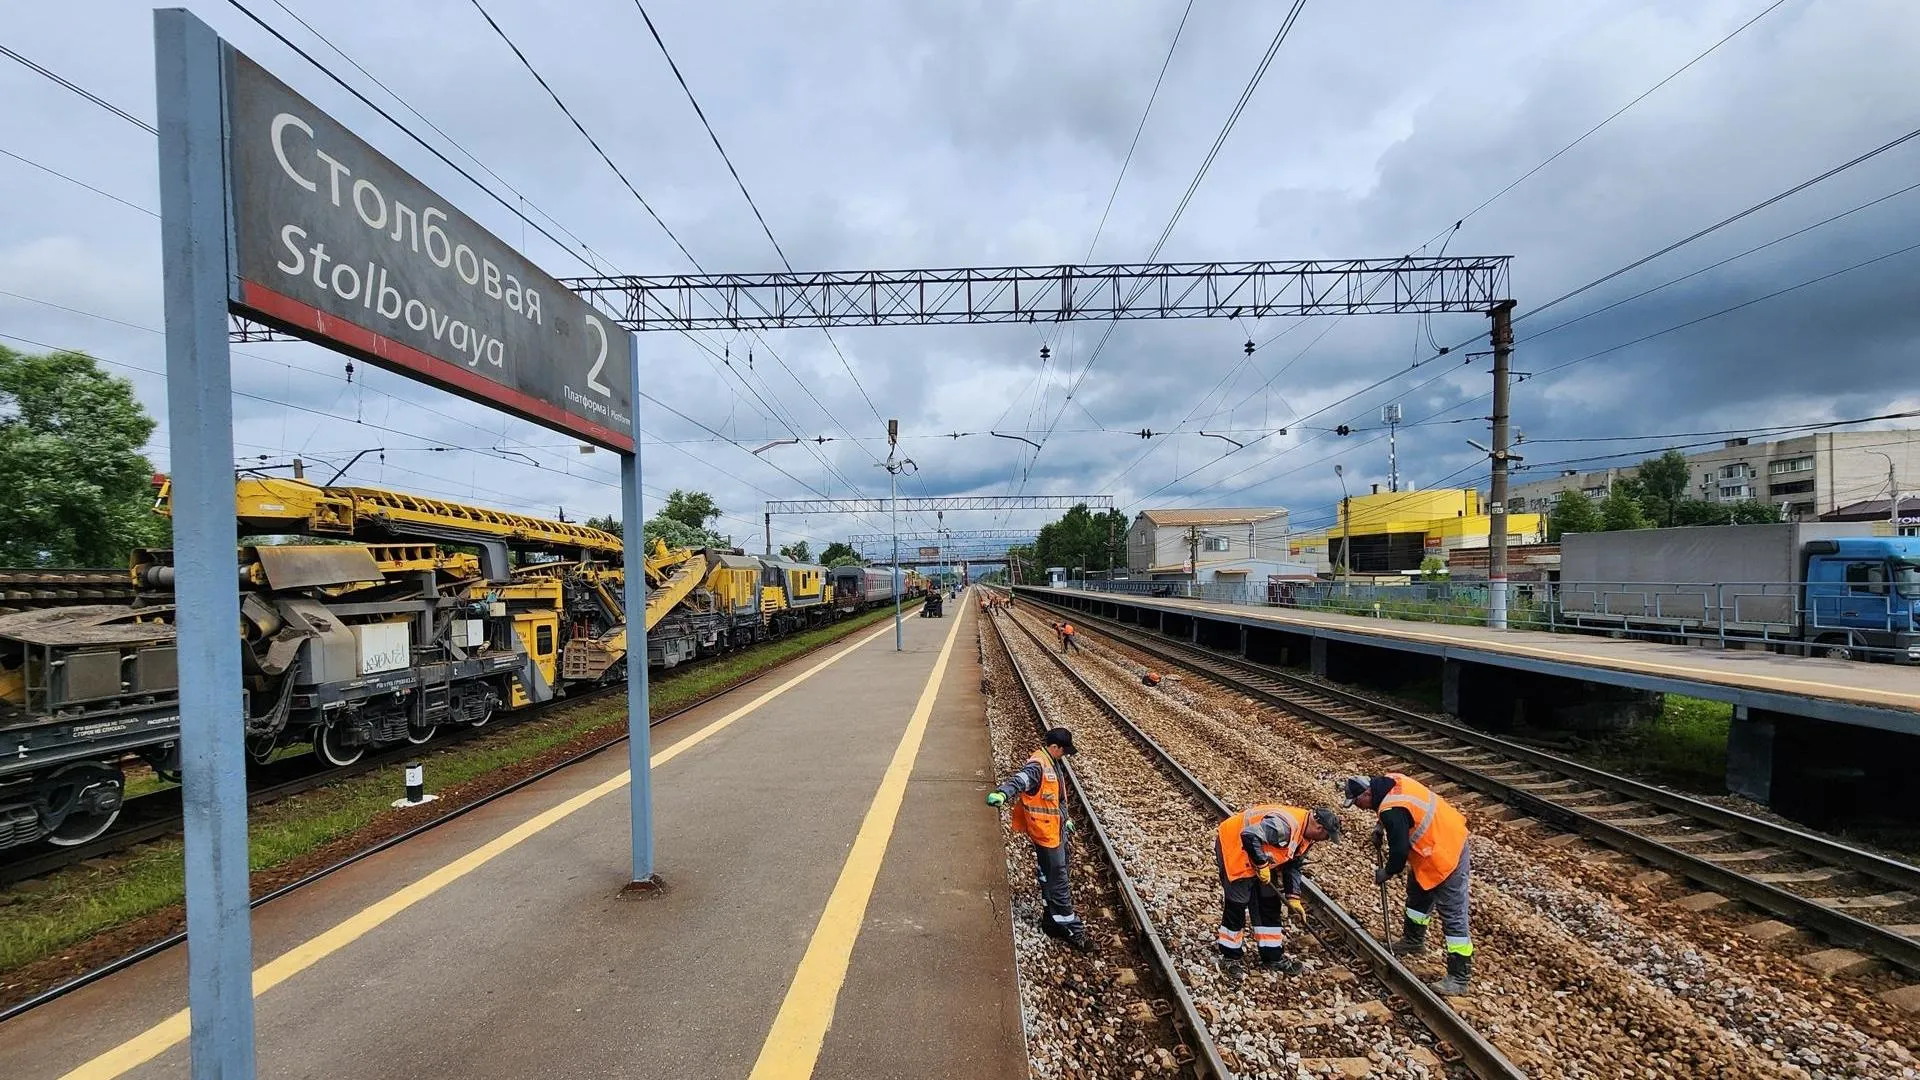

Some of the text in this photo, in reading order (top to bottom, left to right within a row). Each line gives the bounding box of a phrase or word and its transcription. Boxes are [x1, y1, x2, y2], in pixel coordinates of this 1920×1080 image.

[271, 113, 542, 325] Столбовая
[277, 224, 504, 368] Stolbovaya
[564, 384, 607, 415] Платформа
[585, 314, 611, 398] 2
